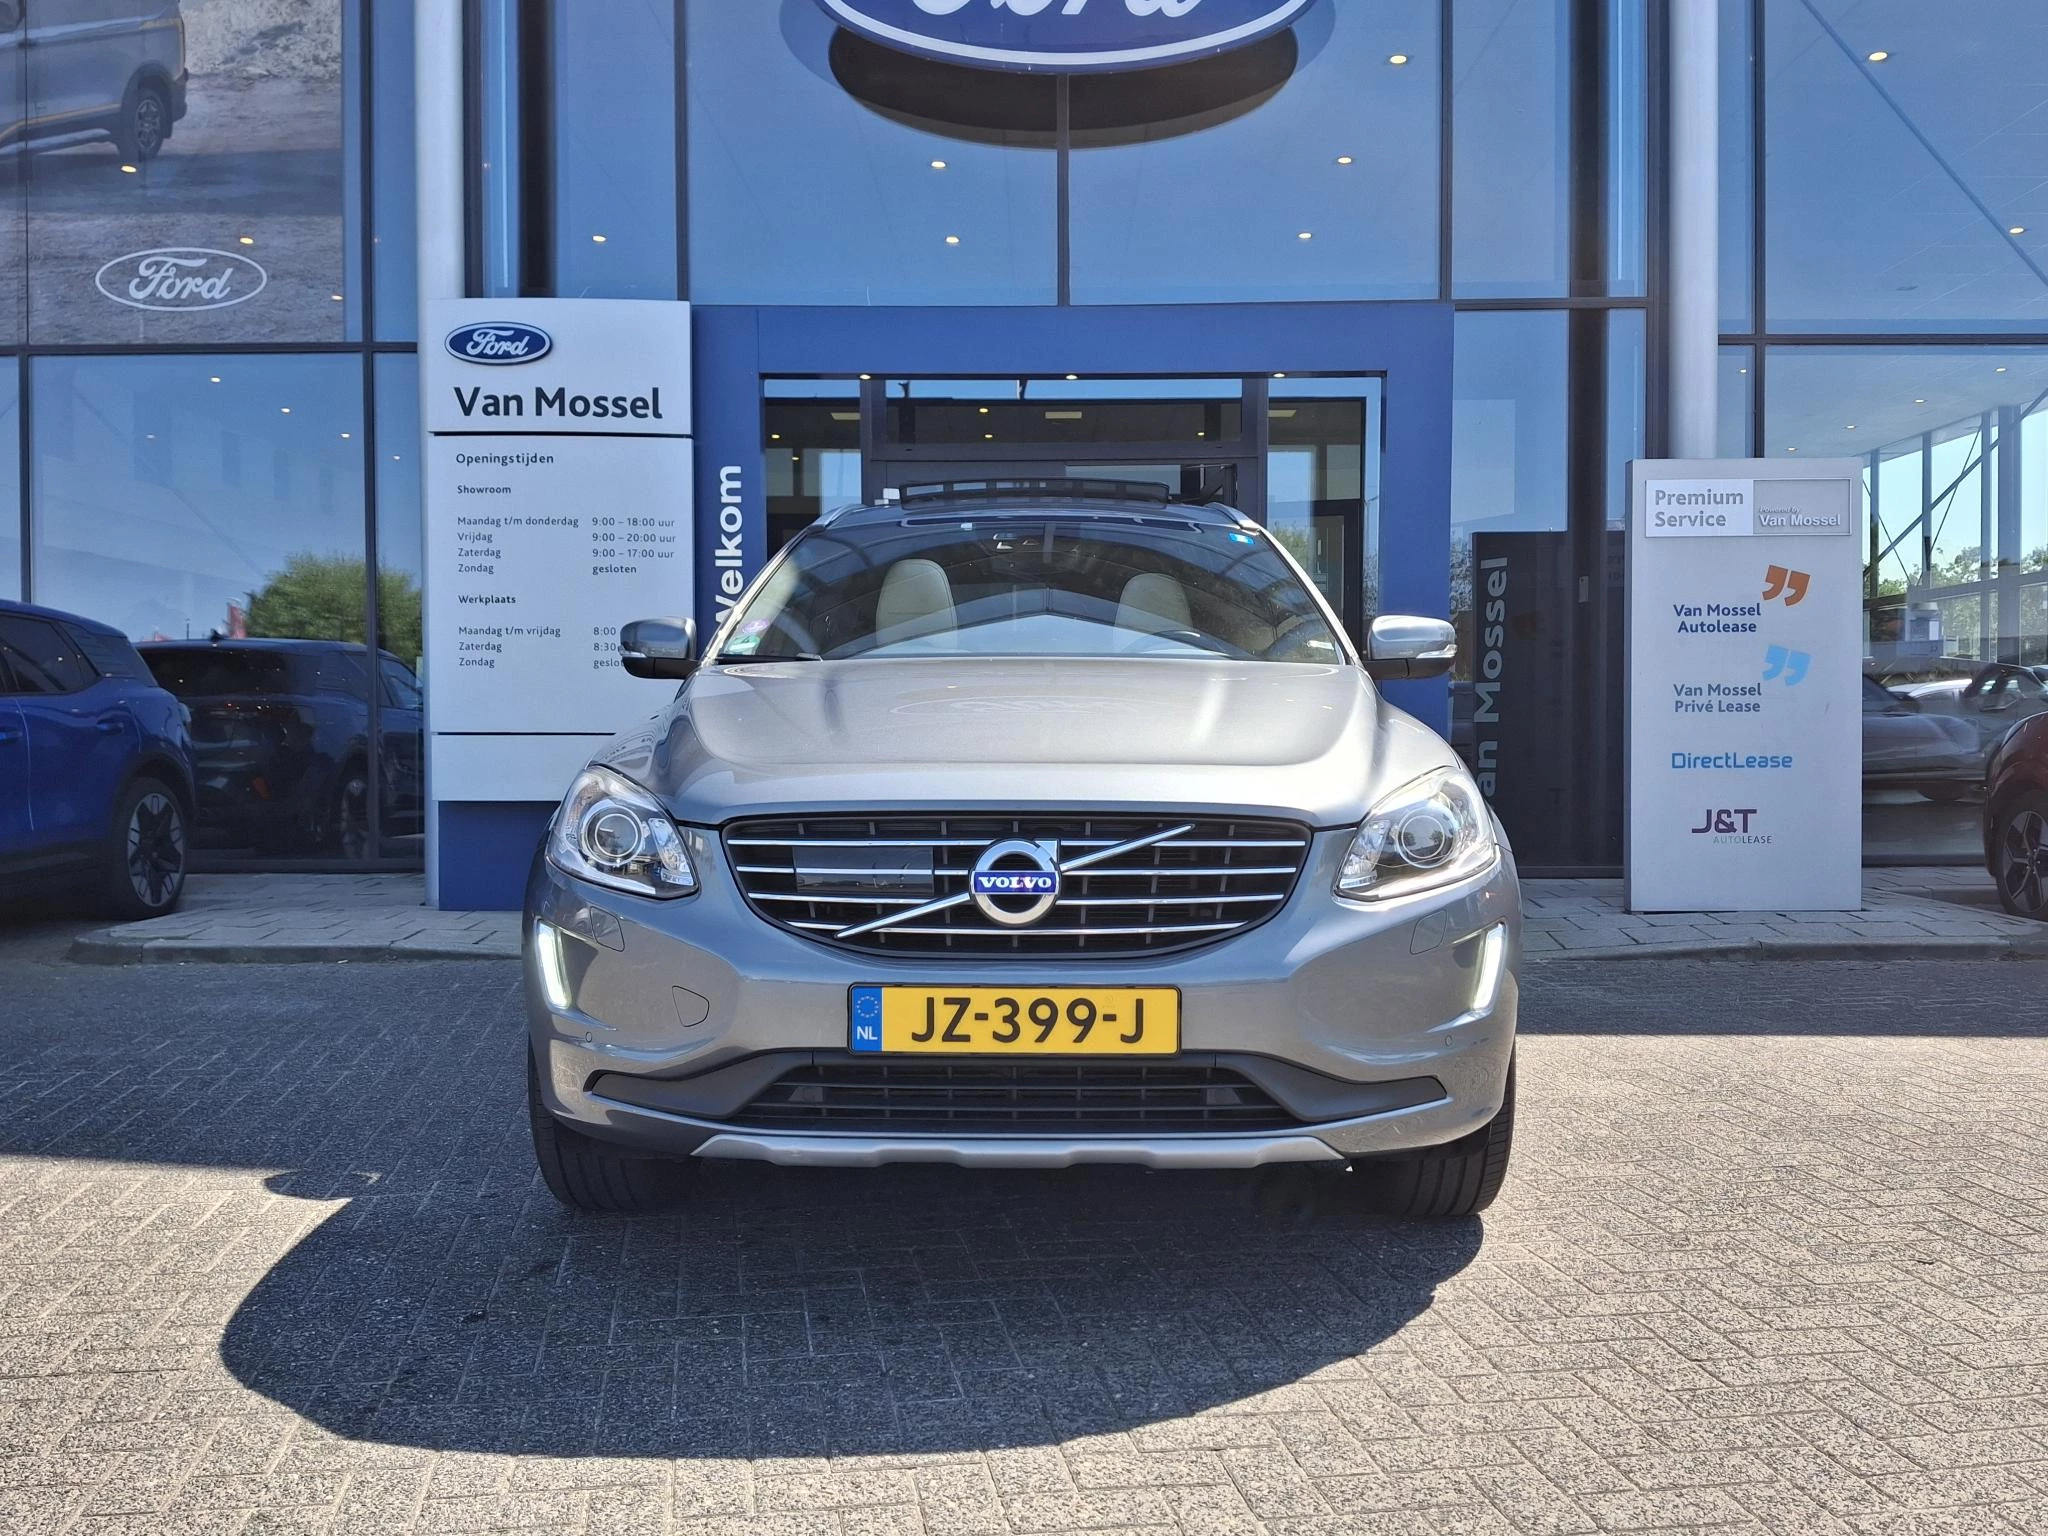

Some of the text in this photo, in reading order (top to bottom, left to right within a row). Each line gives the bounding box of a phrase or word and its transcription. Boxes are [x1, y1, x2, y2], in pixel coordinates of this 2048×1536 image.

[129, 257, 234, 299] Ford
[466, 328, 530, 356] Ford
[454, 387, 663, 419] Van Mossel
[456, 453, 554, 467] Openingstijden
[457, 485, 511, 494] Showroom
[1655, 490, 1744, 505] Premium
[457, 517, 501, 527] Maandag
[504, 517, 523, 525] t/m
[526, 517, 579, 527] donderdag
[592, 518, 615, 527] 9:00
[627, 518, 655, 527] 18:00
[1655, 512, 1727, 527] Service
[1759, 514, 1841, 526] Van Mossel
[457, 532, 493, 543] Vrijdag
[592, 533, 615, 542] 9:00
[627, 533, 656, 542] 20:00
[457, 547, 501, 558] Zaterdag
[592, 549, 615, 558] 9:00
[628, 549, 655, 558] 17:00
[457, 563, 637, 574] Zondag gesloten
[458, 595, 516, 604] Werkplaats
[1673, 603, 1761, 616] Van Mossel
[458, 626, 616, 637] Maandag t/m vrijdag 8:00
[1678, 621, 1757, 633] Autolease
[458, 642, 616, 653] Zaterdag 8:30
[458, 657, 495, 668] Zondag
[1474, 557, 1508, 797] an Mossel
[1673, 683, 1762, 696] Van Mossel
[1674, 700, 1761, 712] Privé Lease
[1671, 752, 1793, 769] DirectLease
[1691, 809, 1757, 834] J&T
[1713, 836, 1772, 844] AUTOLEASE
[979, 876, 1051, 888] VOLVO
[911, 997, 1144, 1043] JZ-399-J
[857, 1025, 877, 1040] NL
